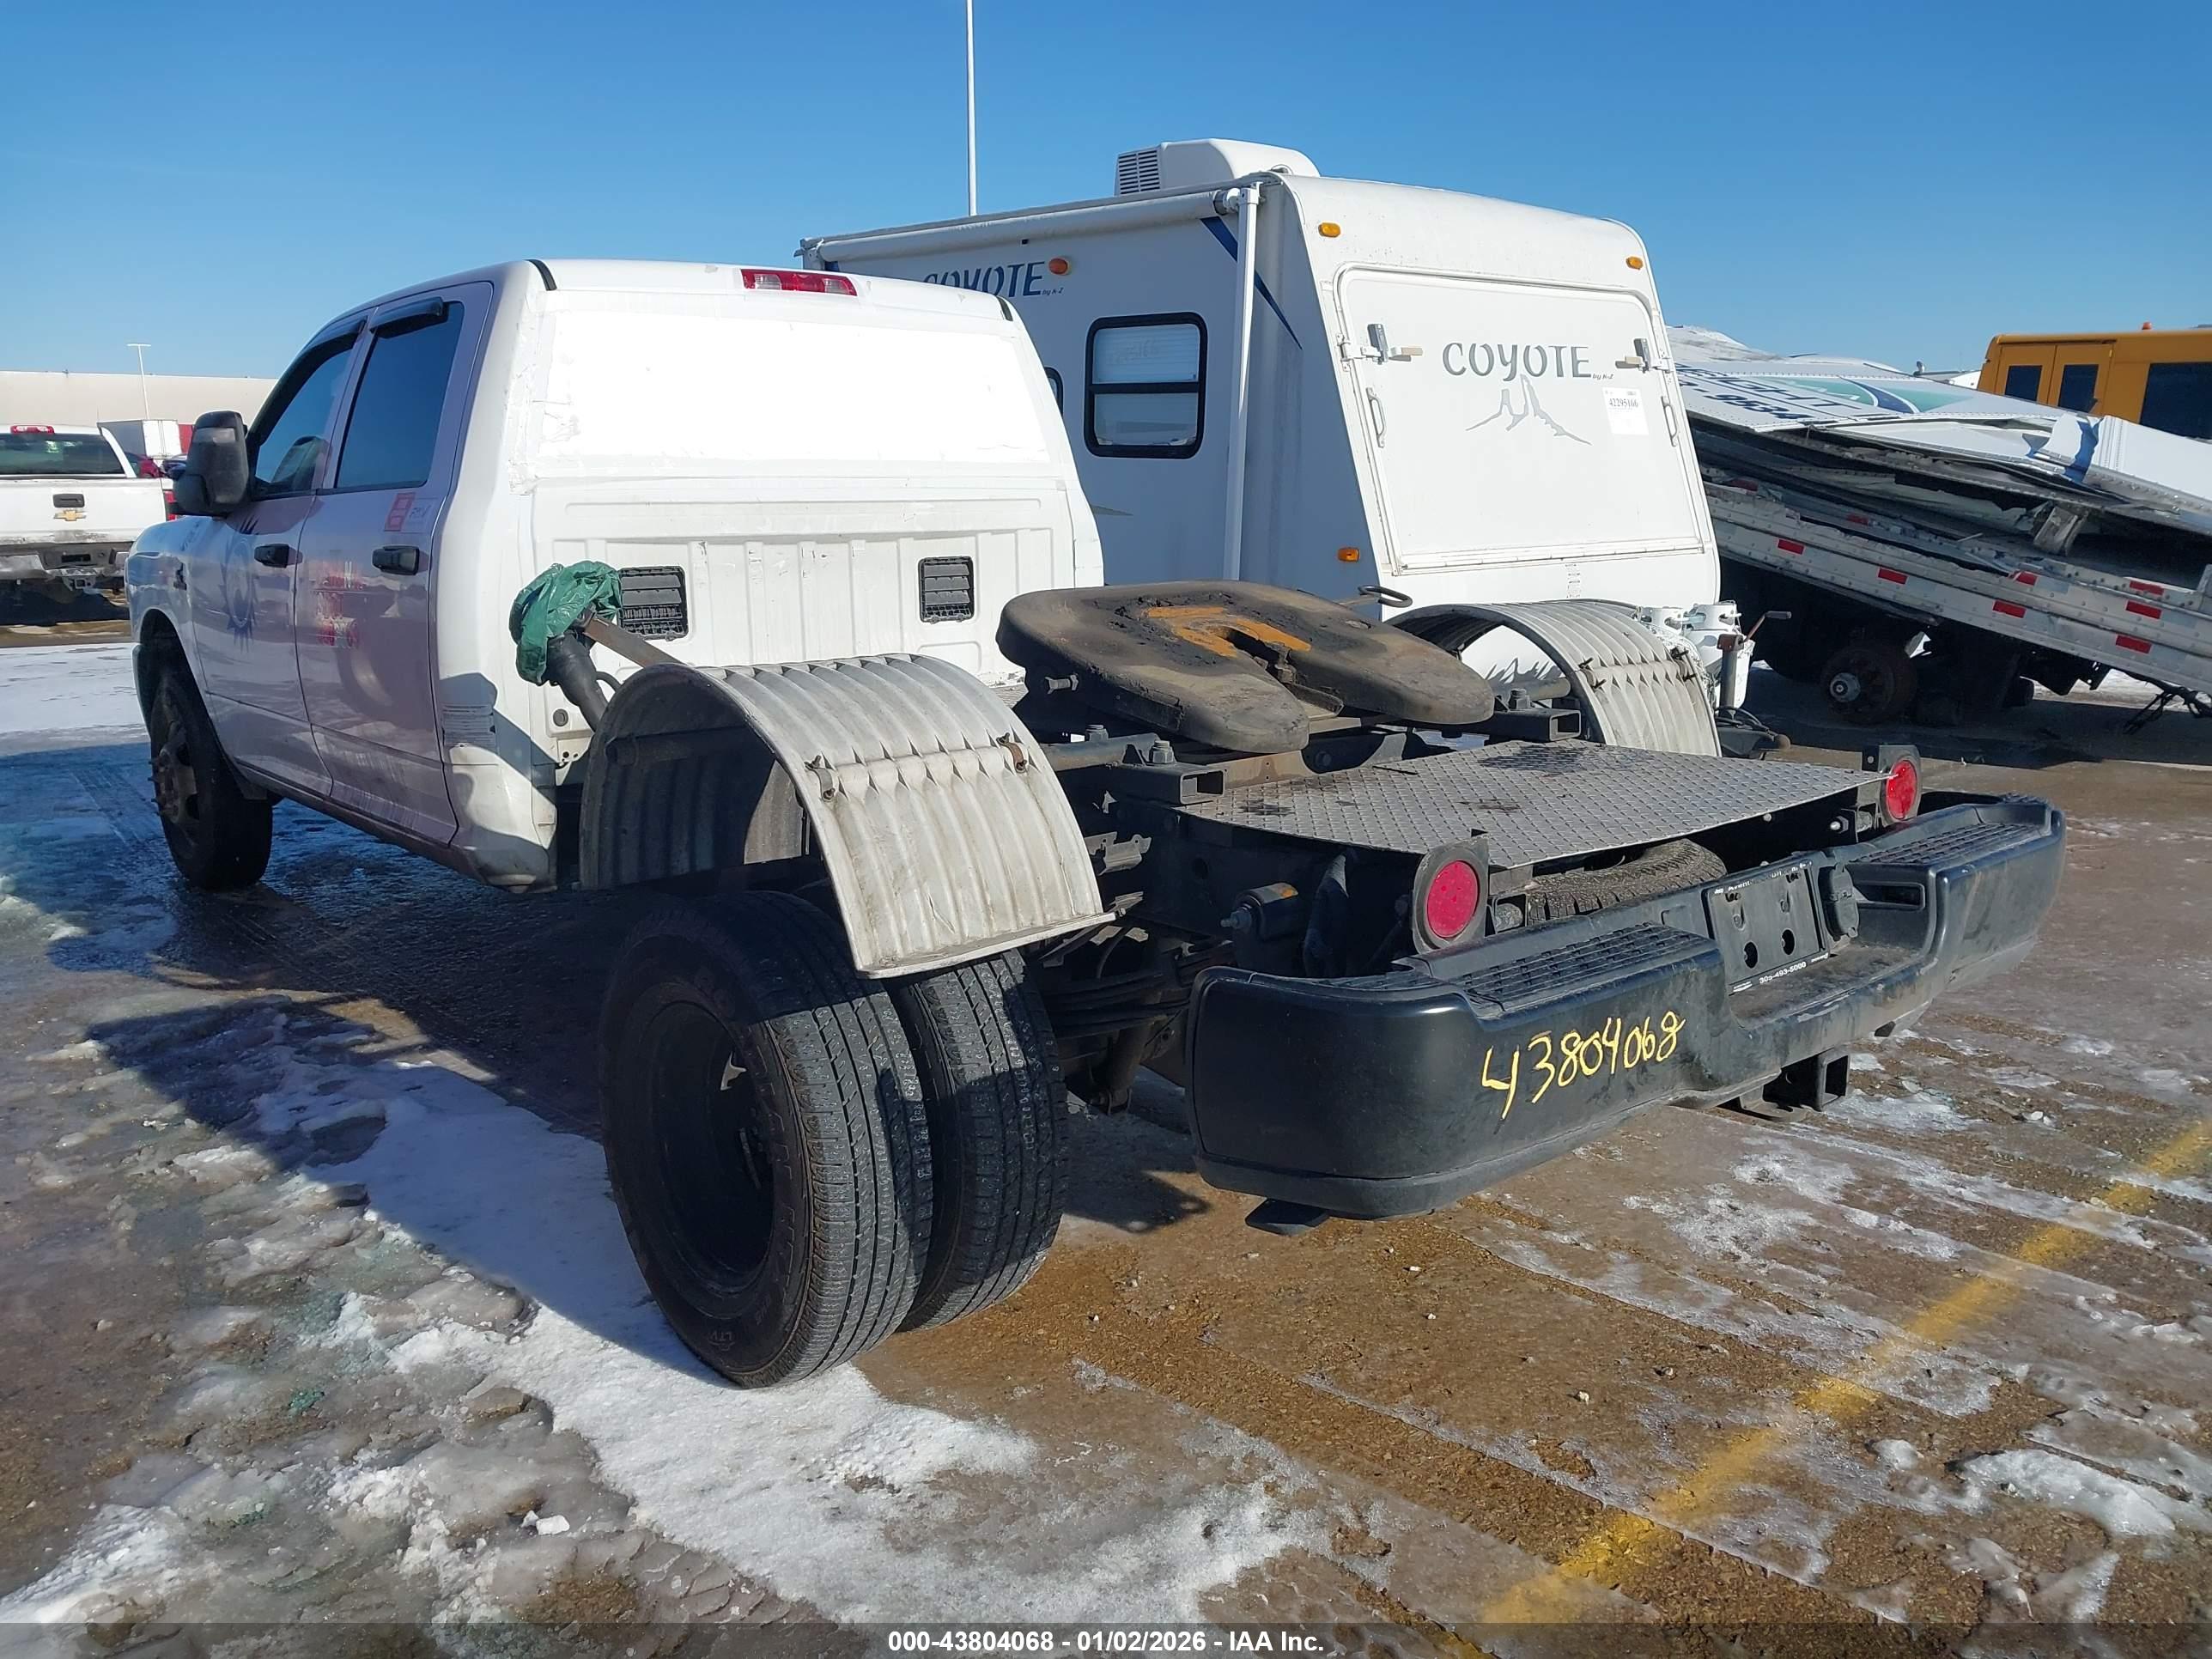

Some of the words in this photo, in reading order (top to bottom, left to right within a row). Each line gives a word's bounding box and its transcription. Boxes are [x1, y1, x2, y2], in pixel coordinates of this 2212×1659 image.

[923, 261, 1045, 298] YOTE
[1442, 342, 1592, 382] COYOTE
[1759, 961, 1807, 984] 305-493-5000
[1481, 1011, 1686, 1120] 43804068
